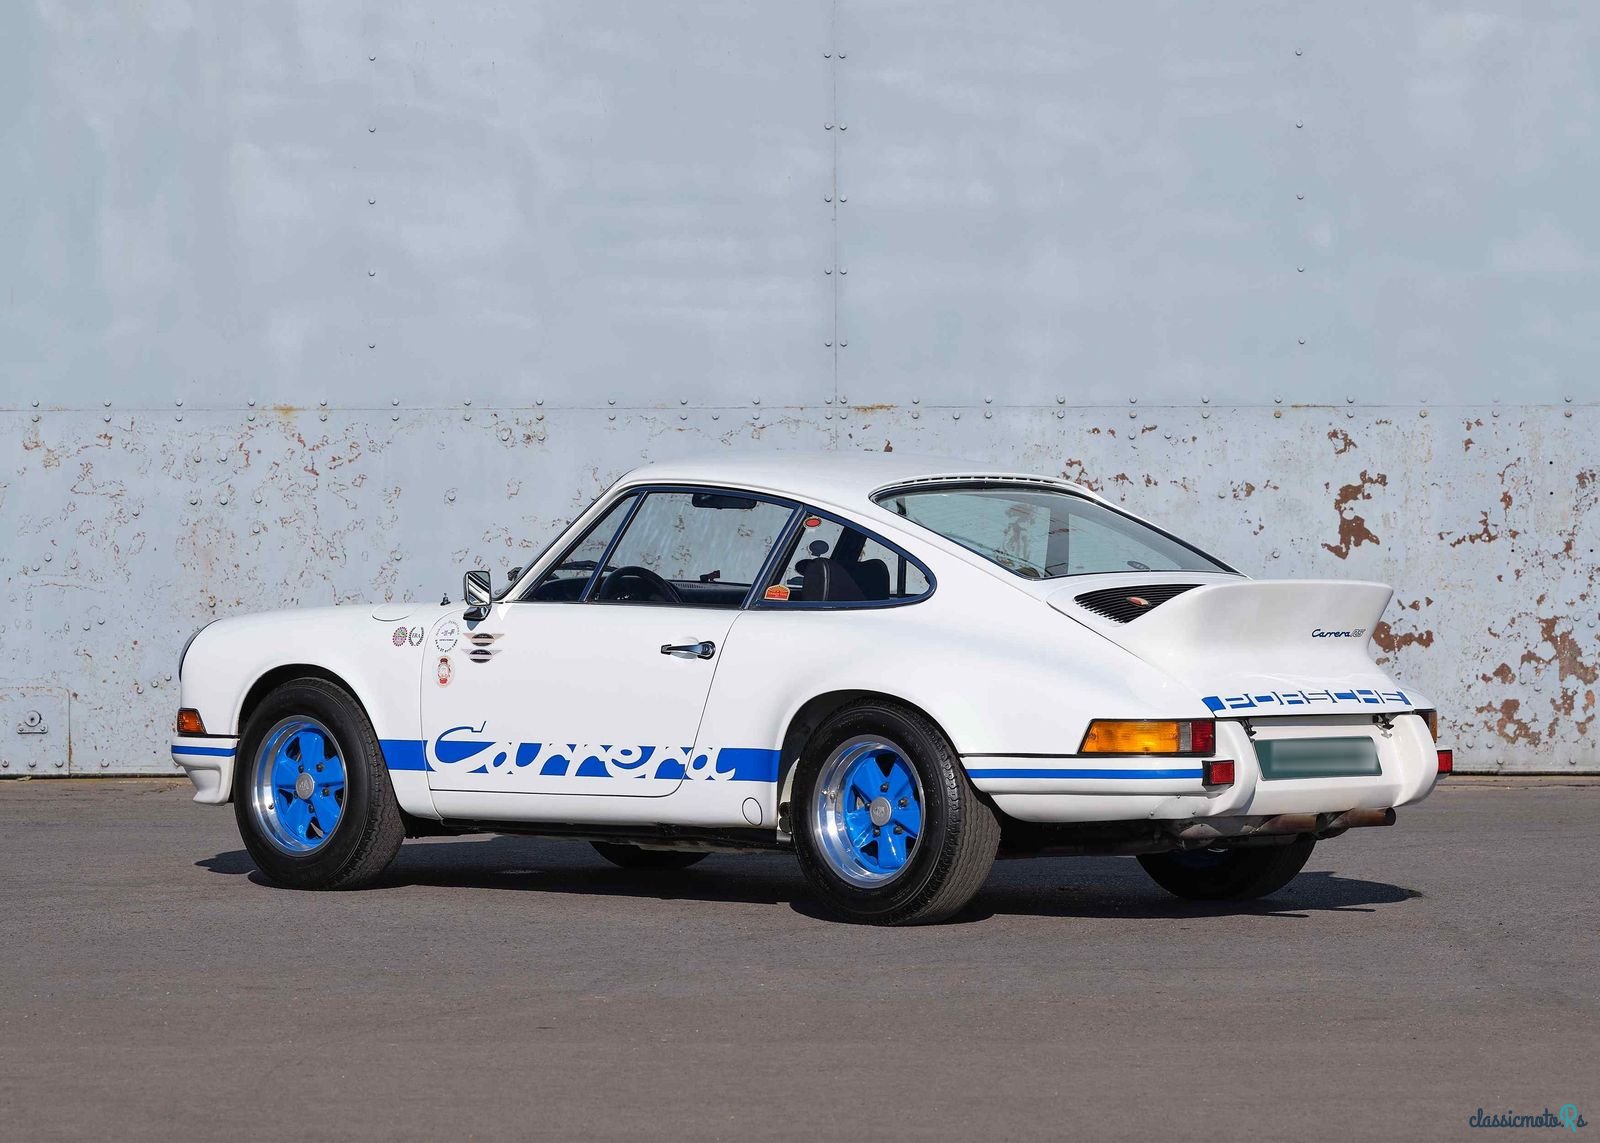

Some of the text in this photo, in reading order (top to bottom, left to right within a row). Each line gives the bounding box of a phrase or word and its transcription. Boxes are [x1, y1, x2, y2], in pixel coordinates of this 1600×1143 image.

[1311, 628, 1352, 638] Carrera
[1218, 689, 1410, 710] PORSCHE
[427, 720, 736, 781] Carrera
